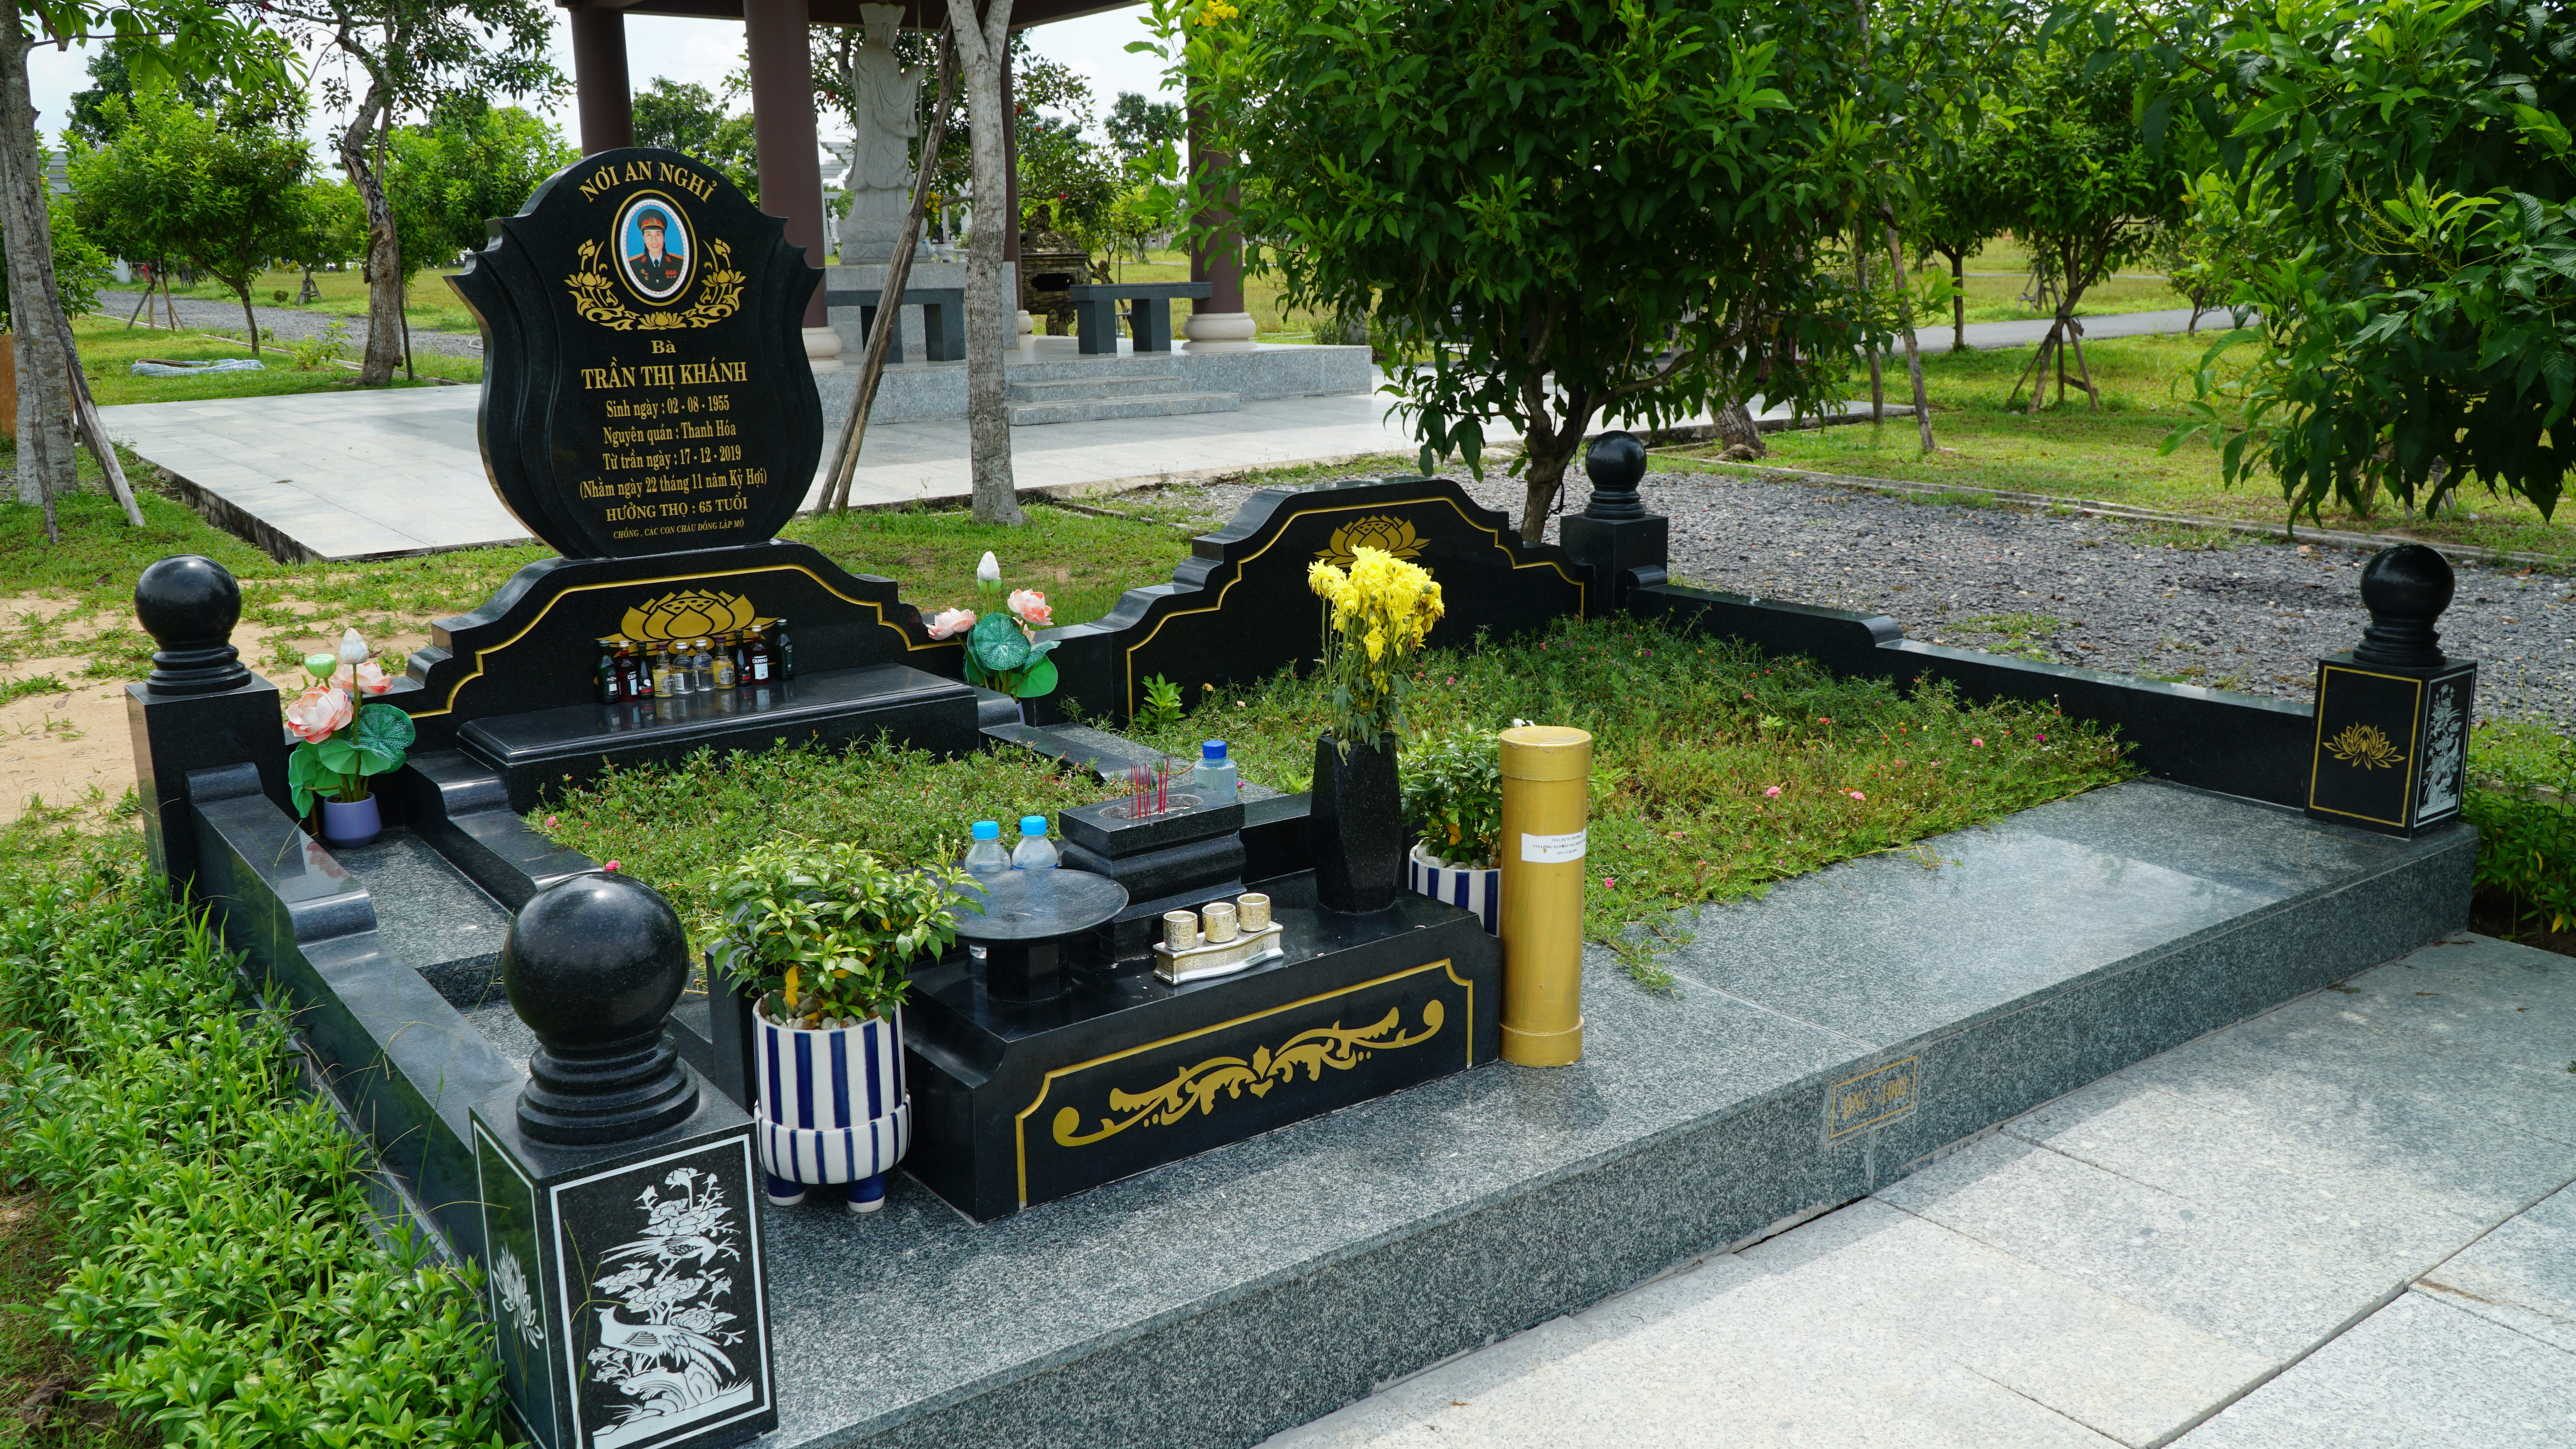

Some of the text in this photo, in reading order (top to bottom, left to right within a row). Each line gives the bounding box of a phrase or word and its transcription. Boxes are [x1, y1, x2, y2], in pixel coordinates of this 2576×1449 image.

[579, 161, 717, 203] NƠI AN NGHỈ
[651, 340, 676, 353] Bà
[581, 356, 747, 390] TRẦN THỊ KHÁNH
[606, 399, 631, 418] Sinh
[633, 398, 658, 419] ngày
[667, 397, 679, 414] 02
[687, 396, 699, 412] 08
[708, 394, 729, 412] 1955
[603, 426, 644, 448] Nguyên
[647, 424, 673, 446] quán
[680, 420, 714, 439] Thanh
[715, 419, 737, 437] Hóa
[602, 453, 618, 470] Từ
[620, 449, 644, 469] trần
[646, 450, 671, 471] ngày
[680, 448, 690, 464] 17
[699, 447, 711, 463] 12
[719, 445, 741, 461] 2019
[580, 467, 767, 500] (Nhằm ngày 22 tháng 11 năm Kỷ Hợi)
[605, 502, 656, 521] HƯỞNG
[659, 503, 688, 518] THỌ
[699, 500, 712, 513] 65
[715, 491, 748, 511] TUỔI
[614, 527, 639, 539] CHỒNG
[644, 525, 658, 536] CÁC
[660, 526, 675, 534] CON
[677, 523, 697, 533] CHÁU
[698, 520, 717, 531] ĐỒNG
[719, 519, 732, 530] LẬP
[734, 518, 744, 529] MỘ
[1841, 1088, 1871, 1119] DNC
[1881, 1075, 1908, 1103] 1002
